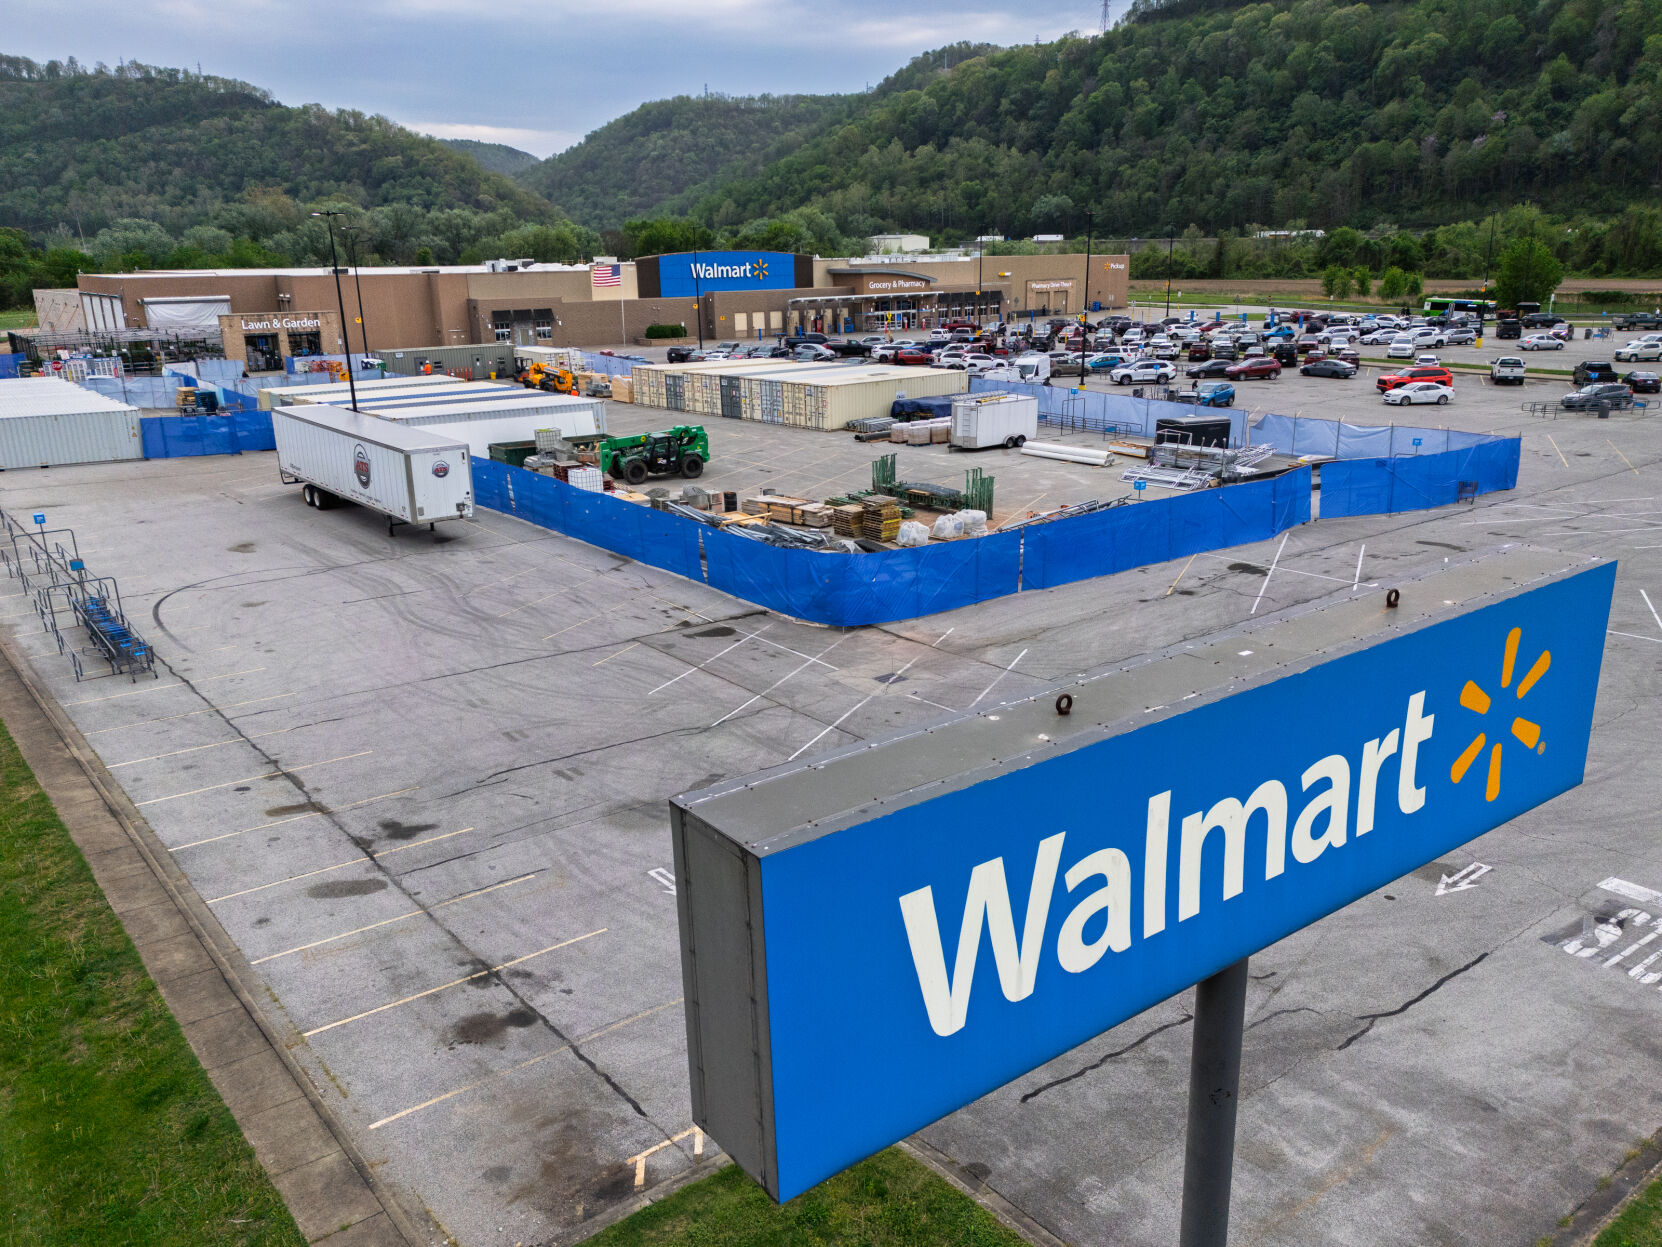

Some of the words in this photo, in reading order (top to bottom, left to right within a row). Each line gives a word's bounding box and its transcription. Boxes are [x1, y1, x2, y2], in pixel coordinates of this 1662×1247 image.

[690, 262, 752, 279] Walmart
[1110, 263, 1125, 271] Pickup
[869, 281, 892, 290] Grocery
[892, 280, 898, 288] &
[898, 280, 926, 288] Pharmacy
[241, 319, 271, 330] Lawn
[272, 318, 281, 329] &
[282, 317, 321, 328] Garden
[355, 460, 369, 473] ATS
[899, 690, 1436, 1038] Walmart
[1561, 907, 1662, 992] ST
